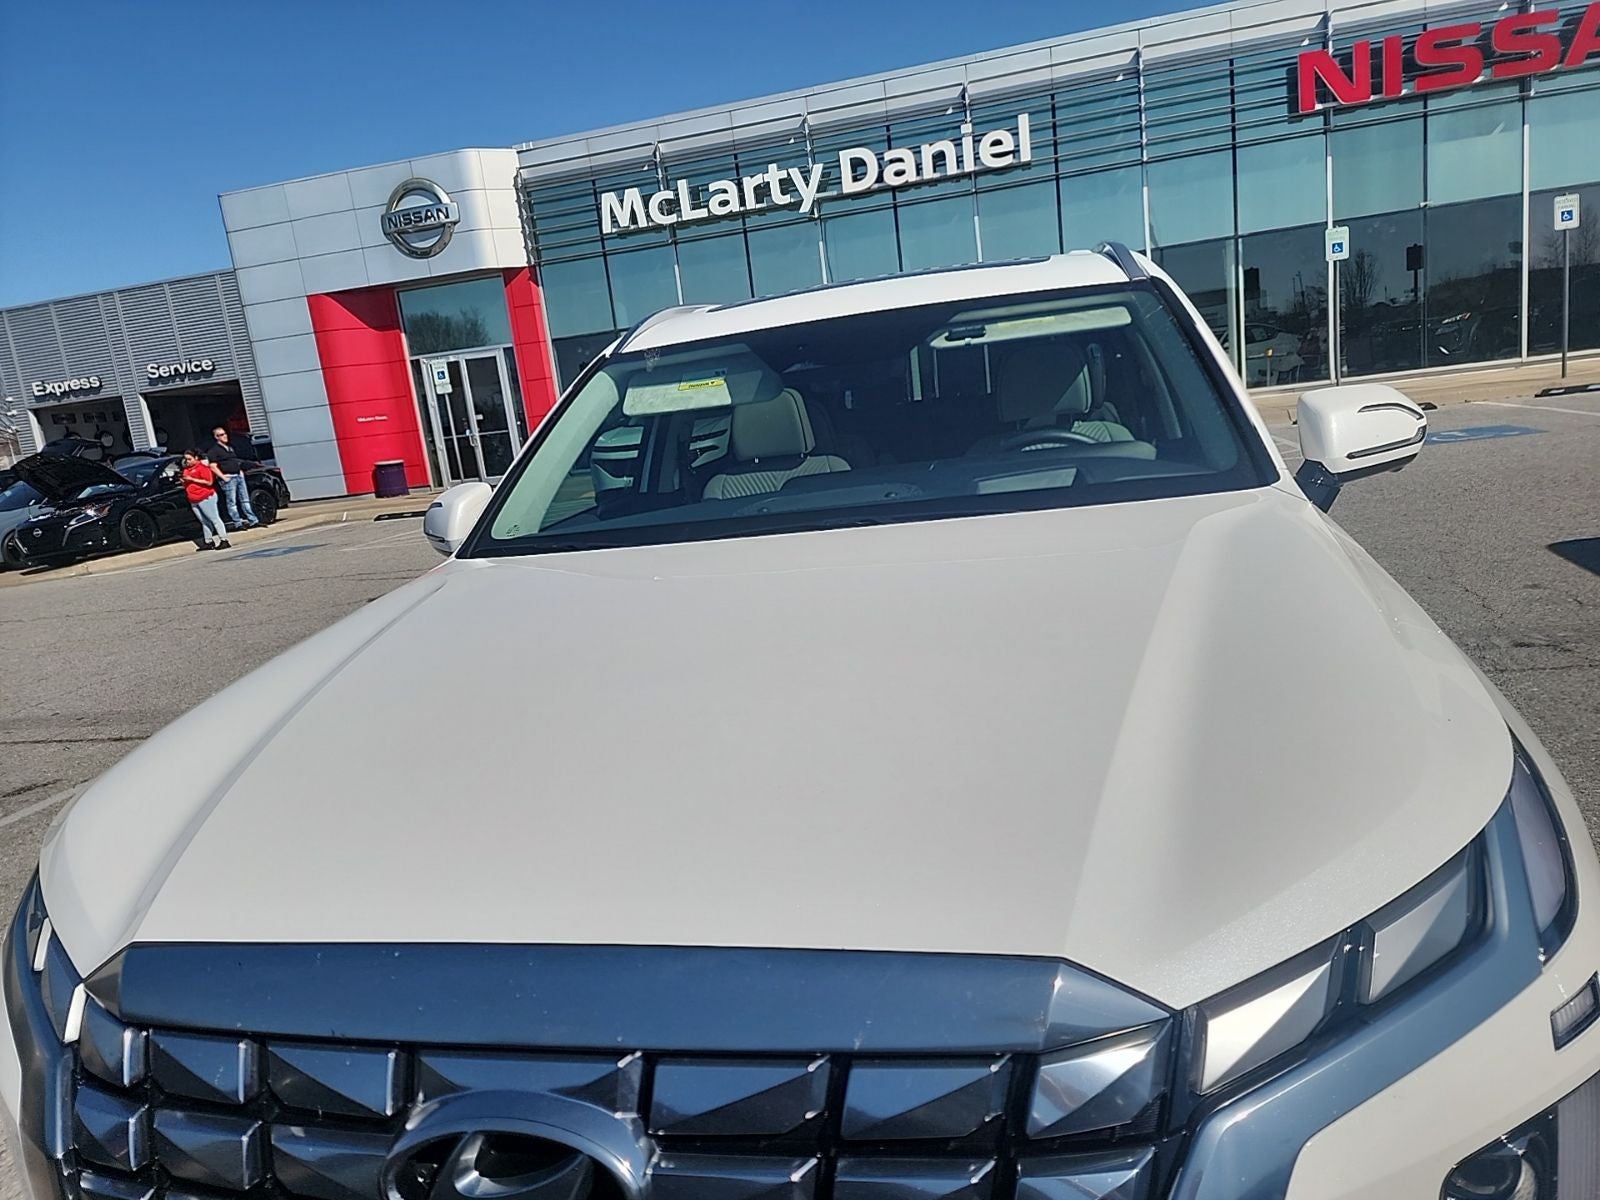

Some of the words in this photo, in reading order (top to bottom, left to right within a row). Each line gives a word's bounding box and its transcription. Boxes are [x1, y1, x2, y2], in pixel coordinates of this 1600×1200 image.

[601, 162, 823, 234] McLarty
[839, 113, 1031, 193] Daniel
[387, 207, 450, 230] NISSAN
[146, 359, 214, 379] Service
[32, 376, 101, 397] Express
